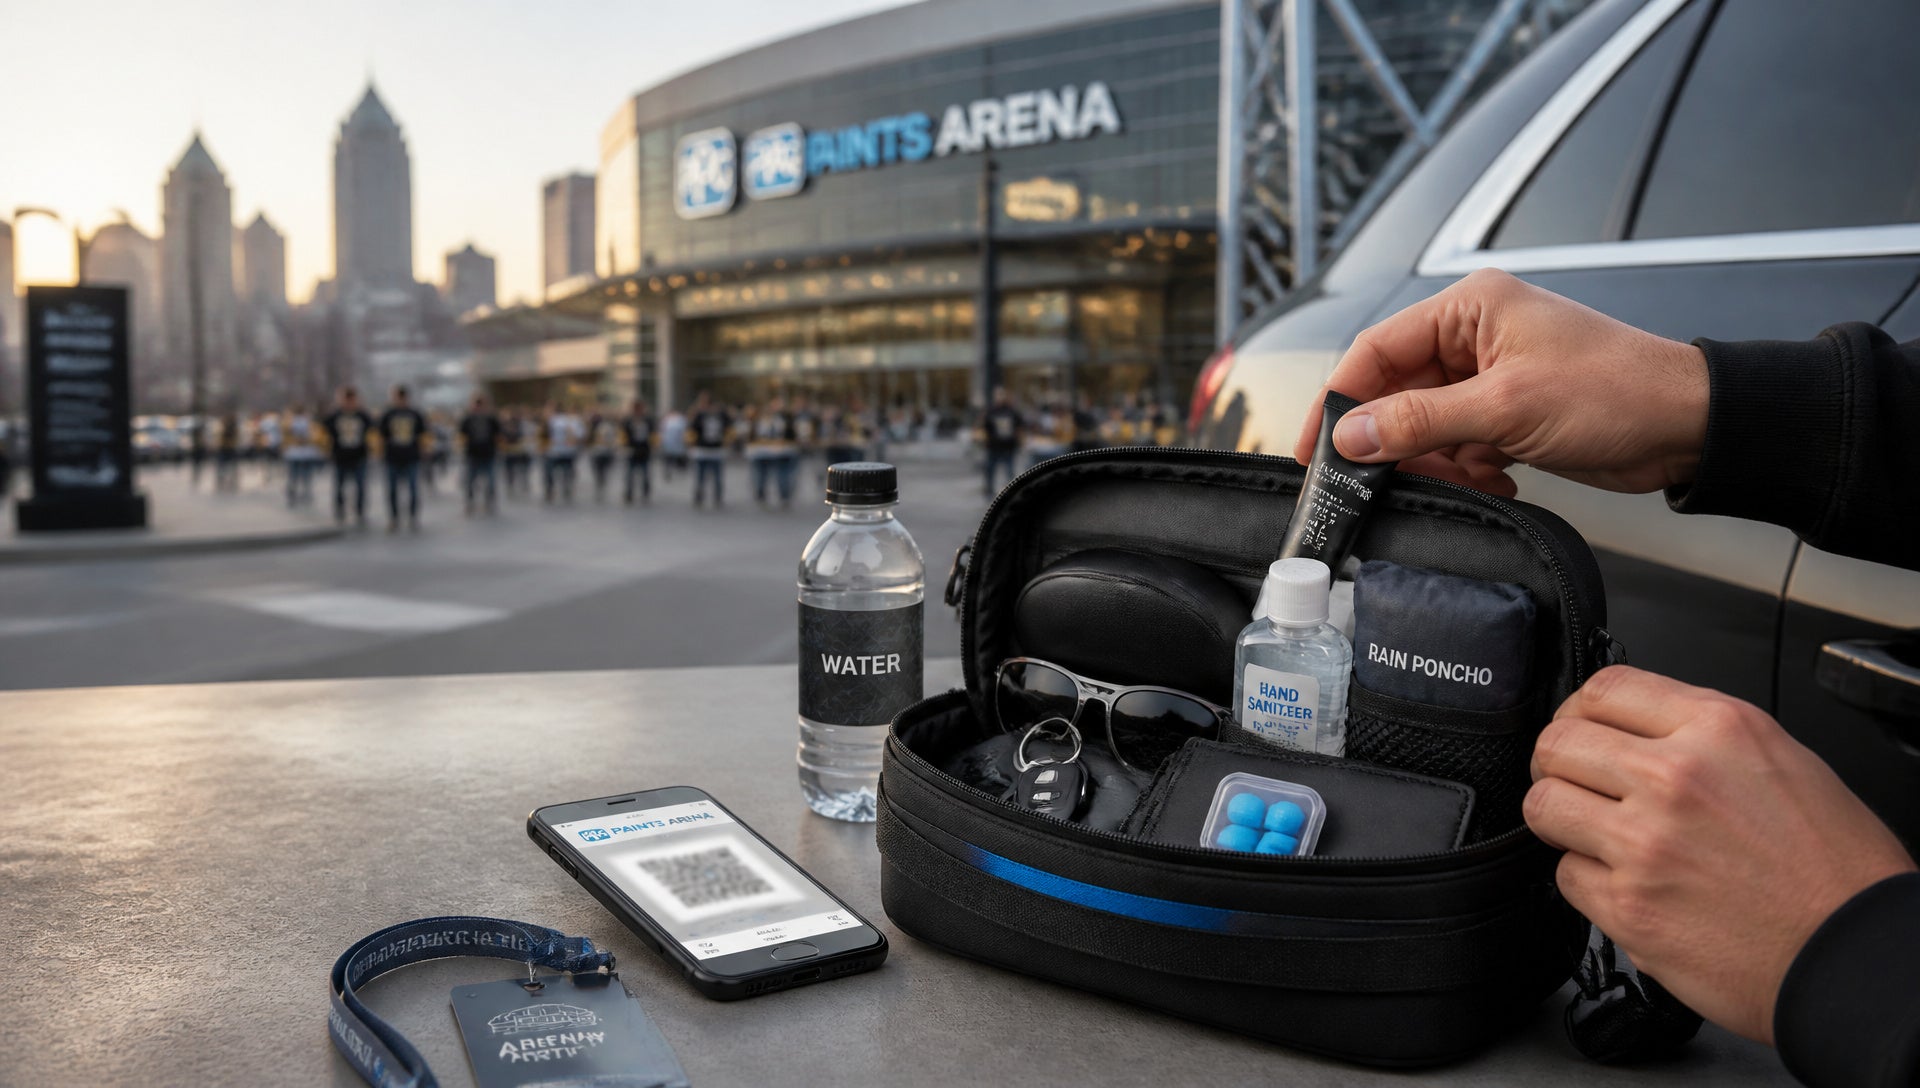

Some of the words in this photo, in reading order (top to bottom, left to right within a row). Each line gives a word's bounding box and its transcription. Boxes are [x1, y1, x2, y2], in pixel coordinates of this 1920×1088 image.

[934, 82, 1121, 157] ARENA
[821, 653, 901, 675] WATER
[1368, 642, 1408, 670] RAIN
[1411, 655, 1493, 686] PONCHO
[1260, 682, 1299, 702] HAND
